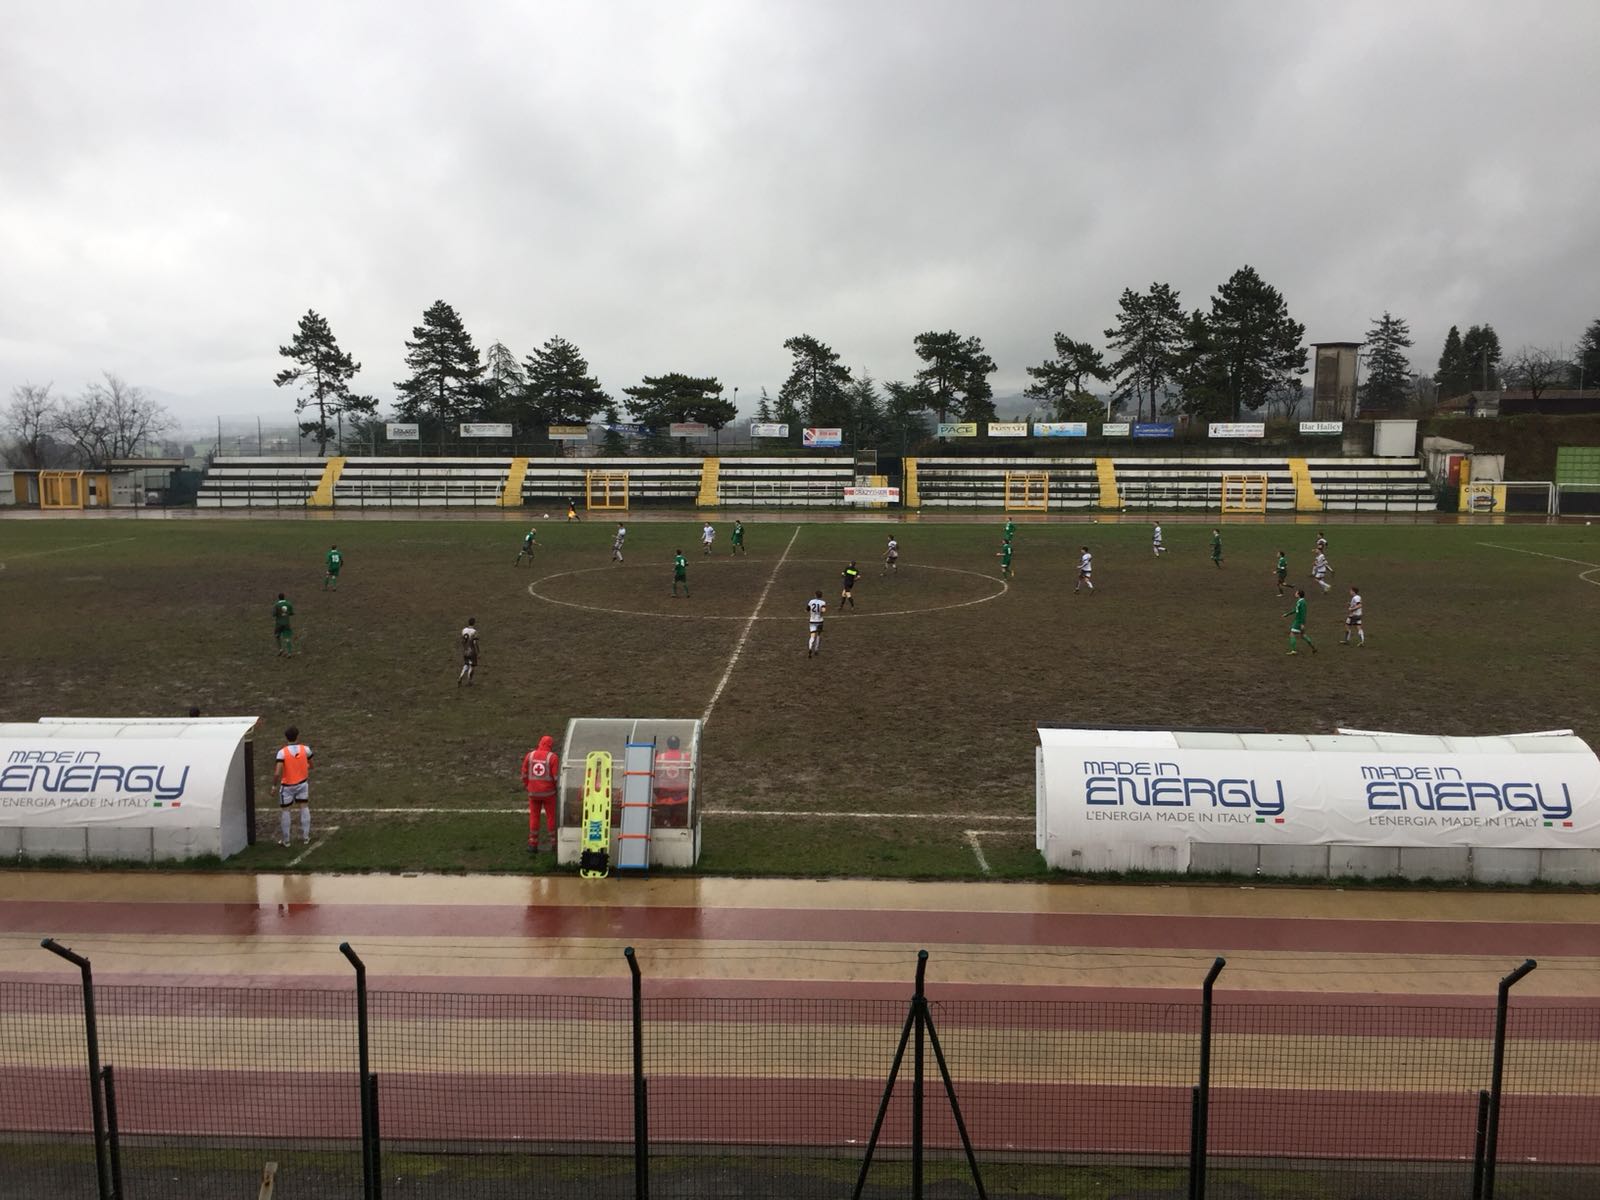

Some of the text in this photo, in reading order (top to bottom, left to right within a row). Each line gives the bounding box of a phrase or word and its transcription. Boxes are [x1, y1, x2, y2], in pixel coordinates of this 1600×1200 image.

[940, 426, 974, 434] PACE
[1301, 422, 1314, 431] Bar
[811, 603, 820, 612] 21
[7, 750, 101, 764] MADE IN
[1084, 761, 1181, 777] MADE IN
[1361, 766, 1462, 780] MADE IN
[0, 765, 190, 801] ENERGY
[61, 797, 97, 809] MADE
[100, 798, 114, 808] IN
[118, 798, 151, 808] ITALY
[1086, 777, 1286, 817] ENERGY
[1366, 781, 1574, 821] ENERGY
[1086, 810, 1252, 824] L'ENERGIA MADE IN ITALY
[1369, 815, 1538, 828] L'ENERGIA MADE IN ITALY
